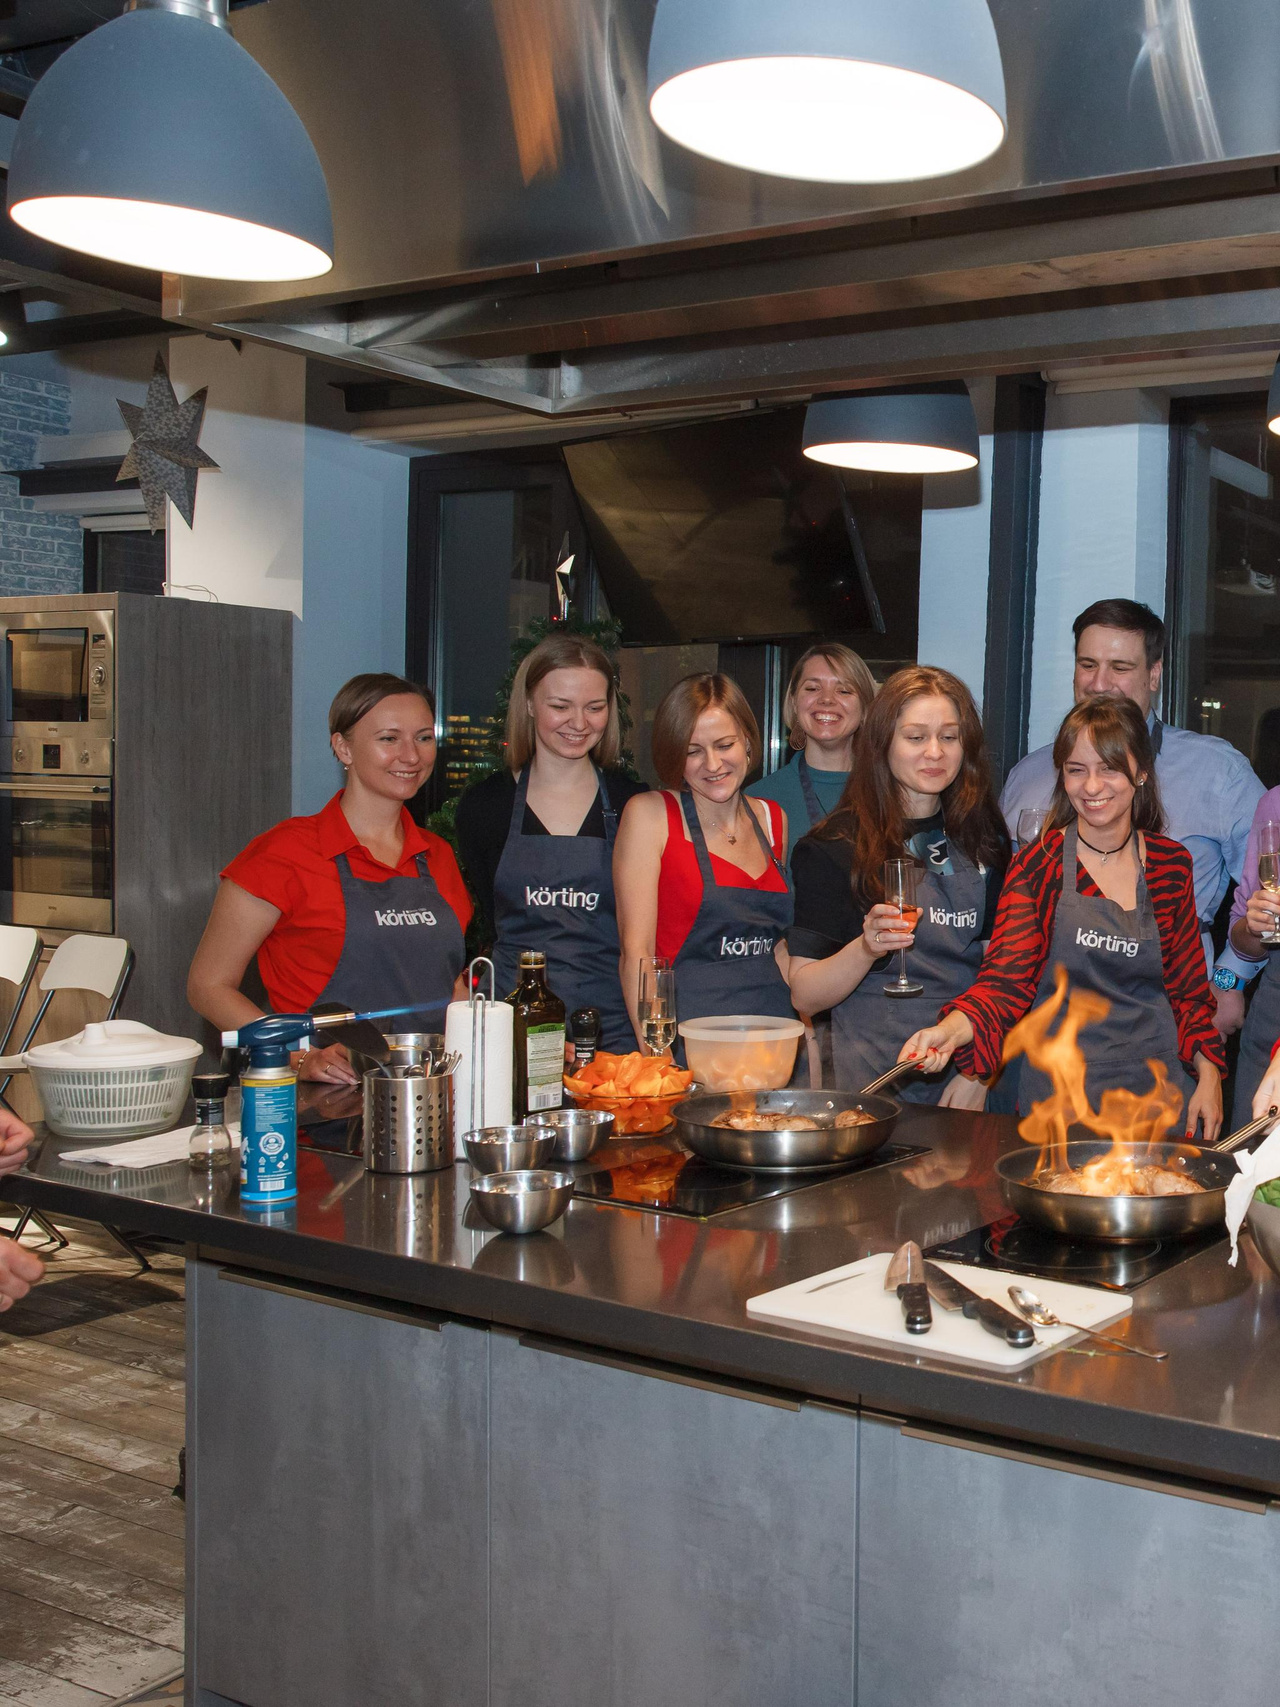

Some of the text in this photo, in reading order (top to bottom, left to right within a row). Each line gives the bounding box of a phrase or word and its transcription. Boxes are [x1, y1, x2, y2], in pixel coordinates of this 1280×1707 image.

[525, 886, 600, 911] körting
[374, 909, 437, 926] körting
[929, 907, 977, 929] körting
[1076, 927, 1139, 957] körting
